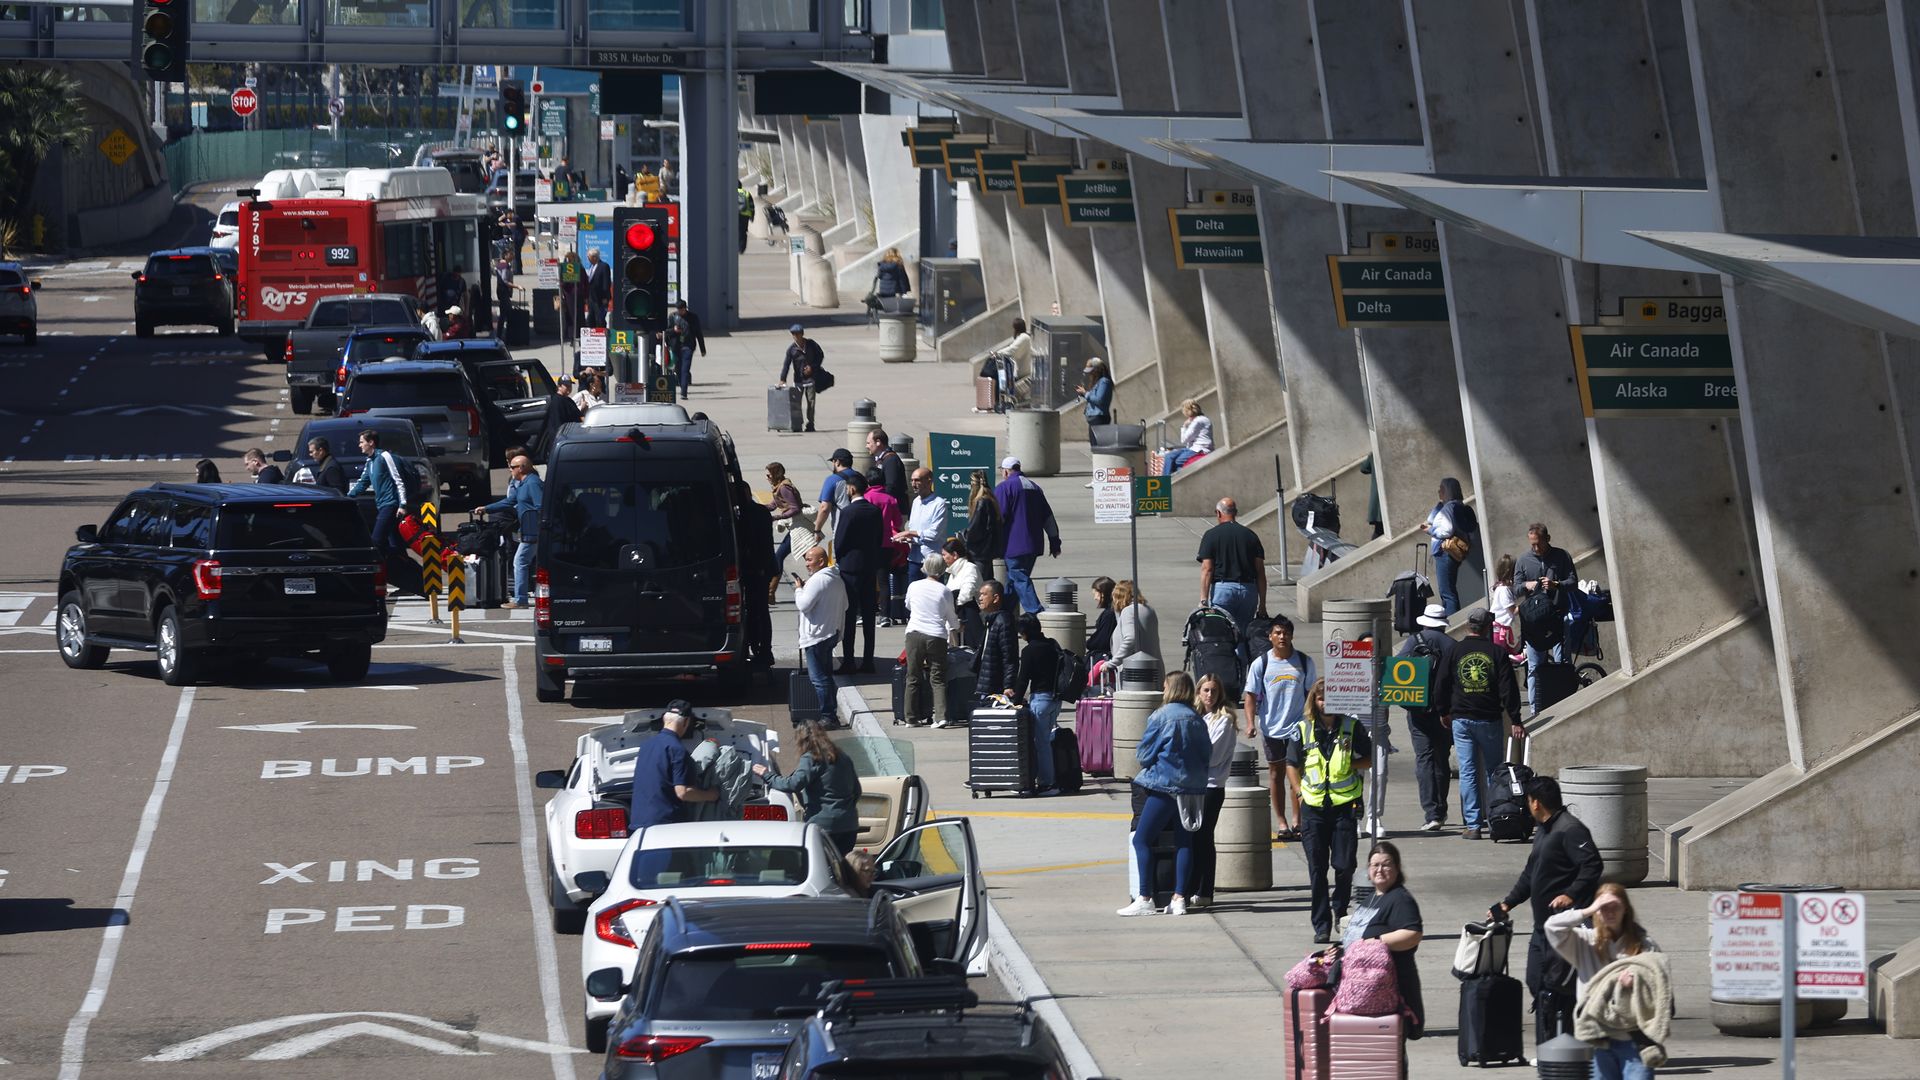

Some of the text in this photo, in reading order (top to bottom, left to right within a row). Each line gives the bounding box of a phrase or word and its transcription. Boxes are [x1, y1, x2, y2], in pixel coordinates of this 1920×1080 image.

[598, 53, 674, 63] 3835 N. Harbor Dr.
[233, 96, 255, 108] STOP
[988, 177, 1016, 188] Bagga
[1084, 184, 1117, 194] JetBlue
[1231, 192, 1256, 207] Bag
[1079, 207, 1110, 217] United
[1195, 219, 1224, 230] Delta
[331, 248, 350, 259] 992
[1194, 246, 1244, 258] Hawaiian
[566, 263, 574, 273] S
[1361, 268, 1432, 281] Air Canada
[262, 291, 307, 305] MTS
[1357, 301, 1392, 314] Delta
[616, 331, 627, 344] R
[1610, 342, 1700, 358] Air Canada
[656, 377, 668, 391] Q
[1615, 382, 1668, 398] Alaska
[1147, 479, 1161, 497] P
[1139, 500, 1169, 511] ZONE
[1343, 649, 1372, 657] PARKING
[1392, 660, 1416, 685] O
[1340, 685, 1370, 693] WAITING
[1383, 689, 1425, 703] ZONE
[259, 755, 486, 779] BUMP
[258, 857, 481, 885] XING
[1740, 896, 1754, 905] NO
[1740, 907, 1781, 917] PARKING
[263, 904, 466, 934] PED
[1728, 926, 1767, 935] ACTIVE
[1820, 926, 1839, 936] NO
[1715, 962, 1781, 971] NO WAITING
[1797, 973, 1861, 983] ON SIDEWALK
